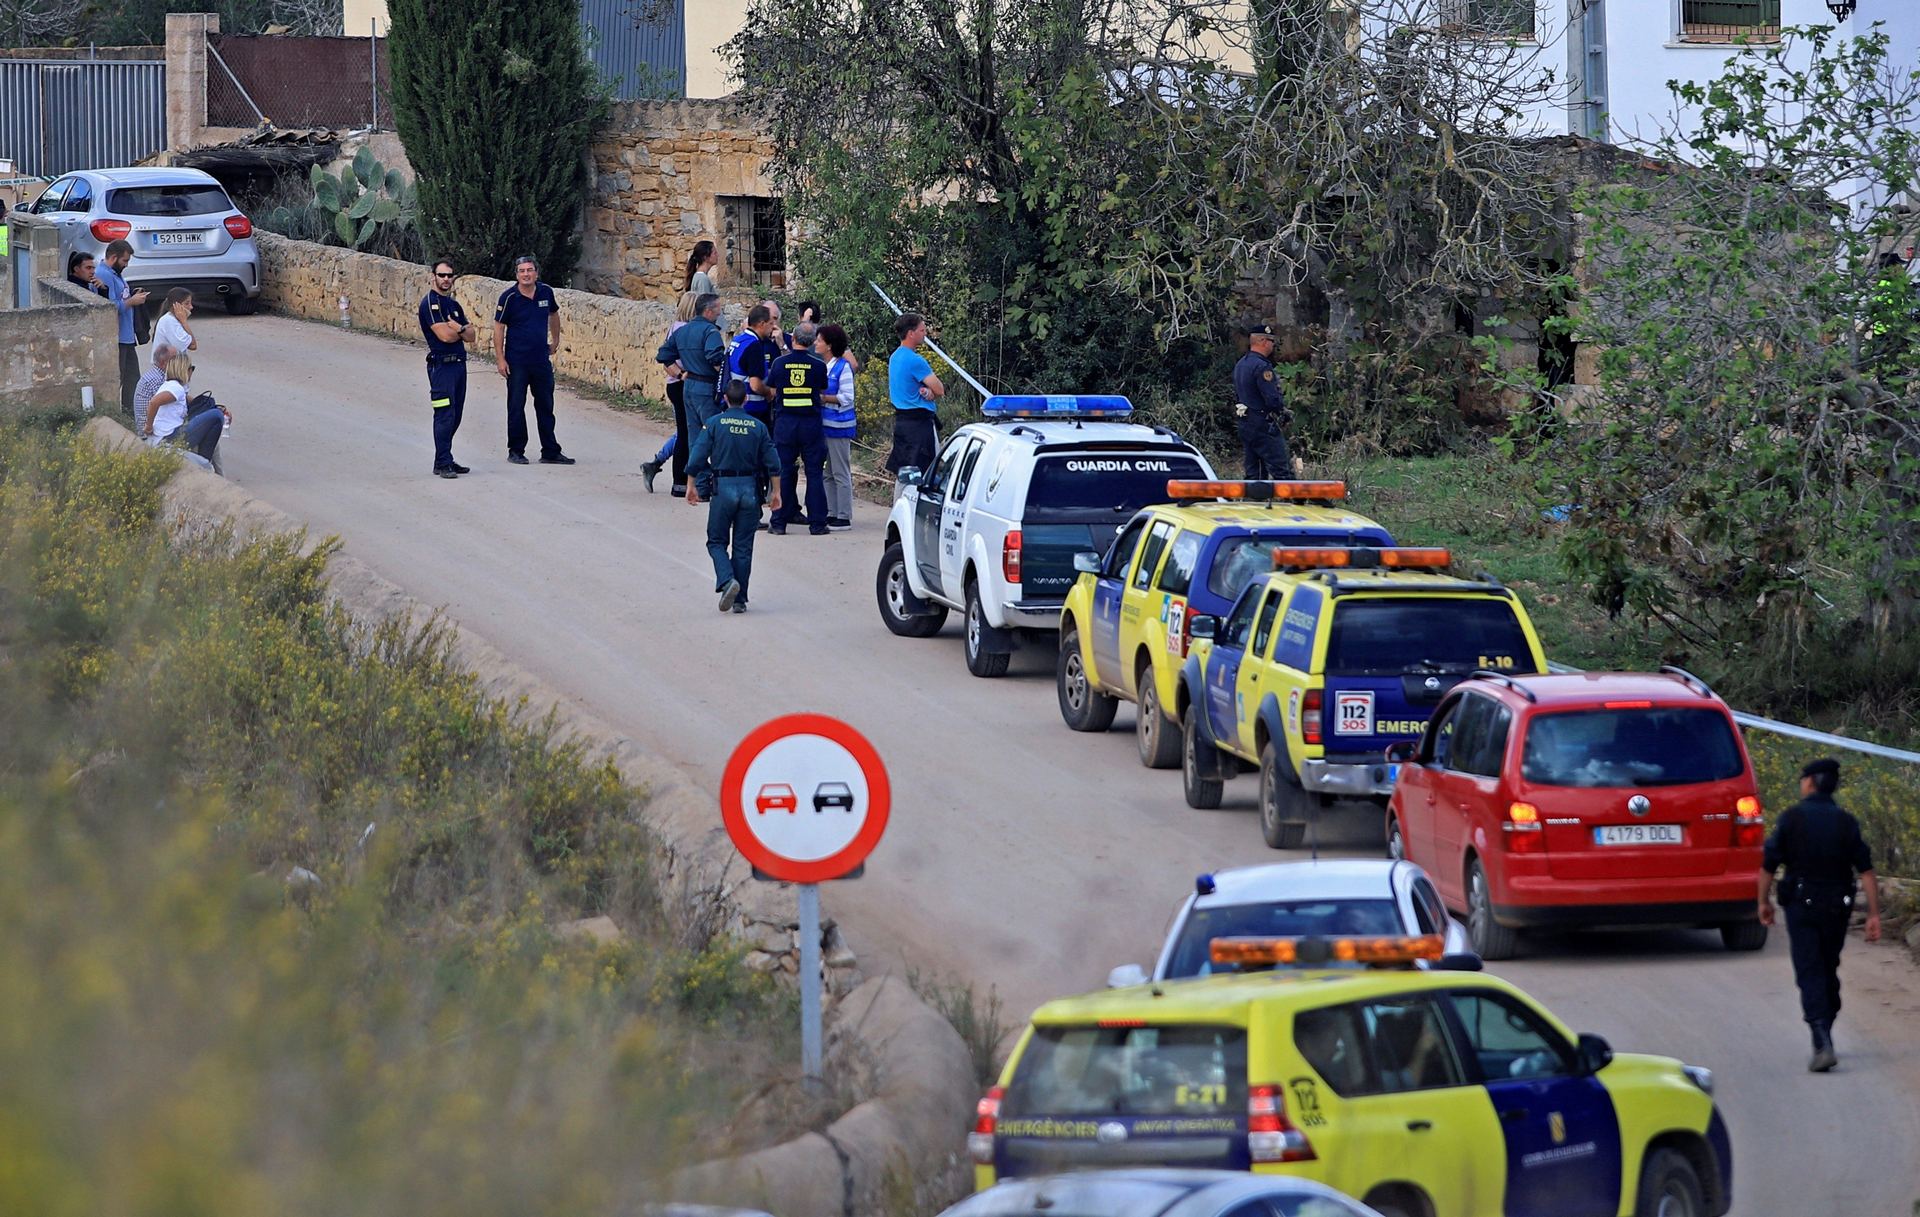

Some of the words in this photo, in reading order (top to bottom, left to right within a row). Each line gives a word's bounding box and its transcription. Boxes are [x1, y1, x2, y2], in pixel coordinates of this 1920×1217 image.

[160, 234, 183, 243] 5219
[185, 233, 202, 243] HWK
[720, 418, 744, 426] GUARDIA
[743, 419, 756, 428] CIVIL
[1066, 460, 1132, 472] GUARDIA
[1134, 460, 1171, 472] CIVIL
[1169, 611, 1181, 635] 112
[1168, 635, 1180, 652] SOS
[1478, 655, 1514, 669] E-10
[1342, 705, 1367, 719] 112
[1342, 719, 1367, 731] SOS
[1606, 827, 1644, 841] 4179
[1649, 826, 1677, 841] DDL
[1175, 1083, 1227, 1106] E-21
[1294, 1089, 1319, 1111] 112
